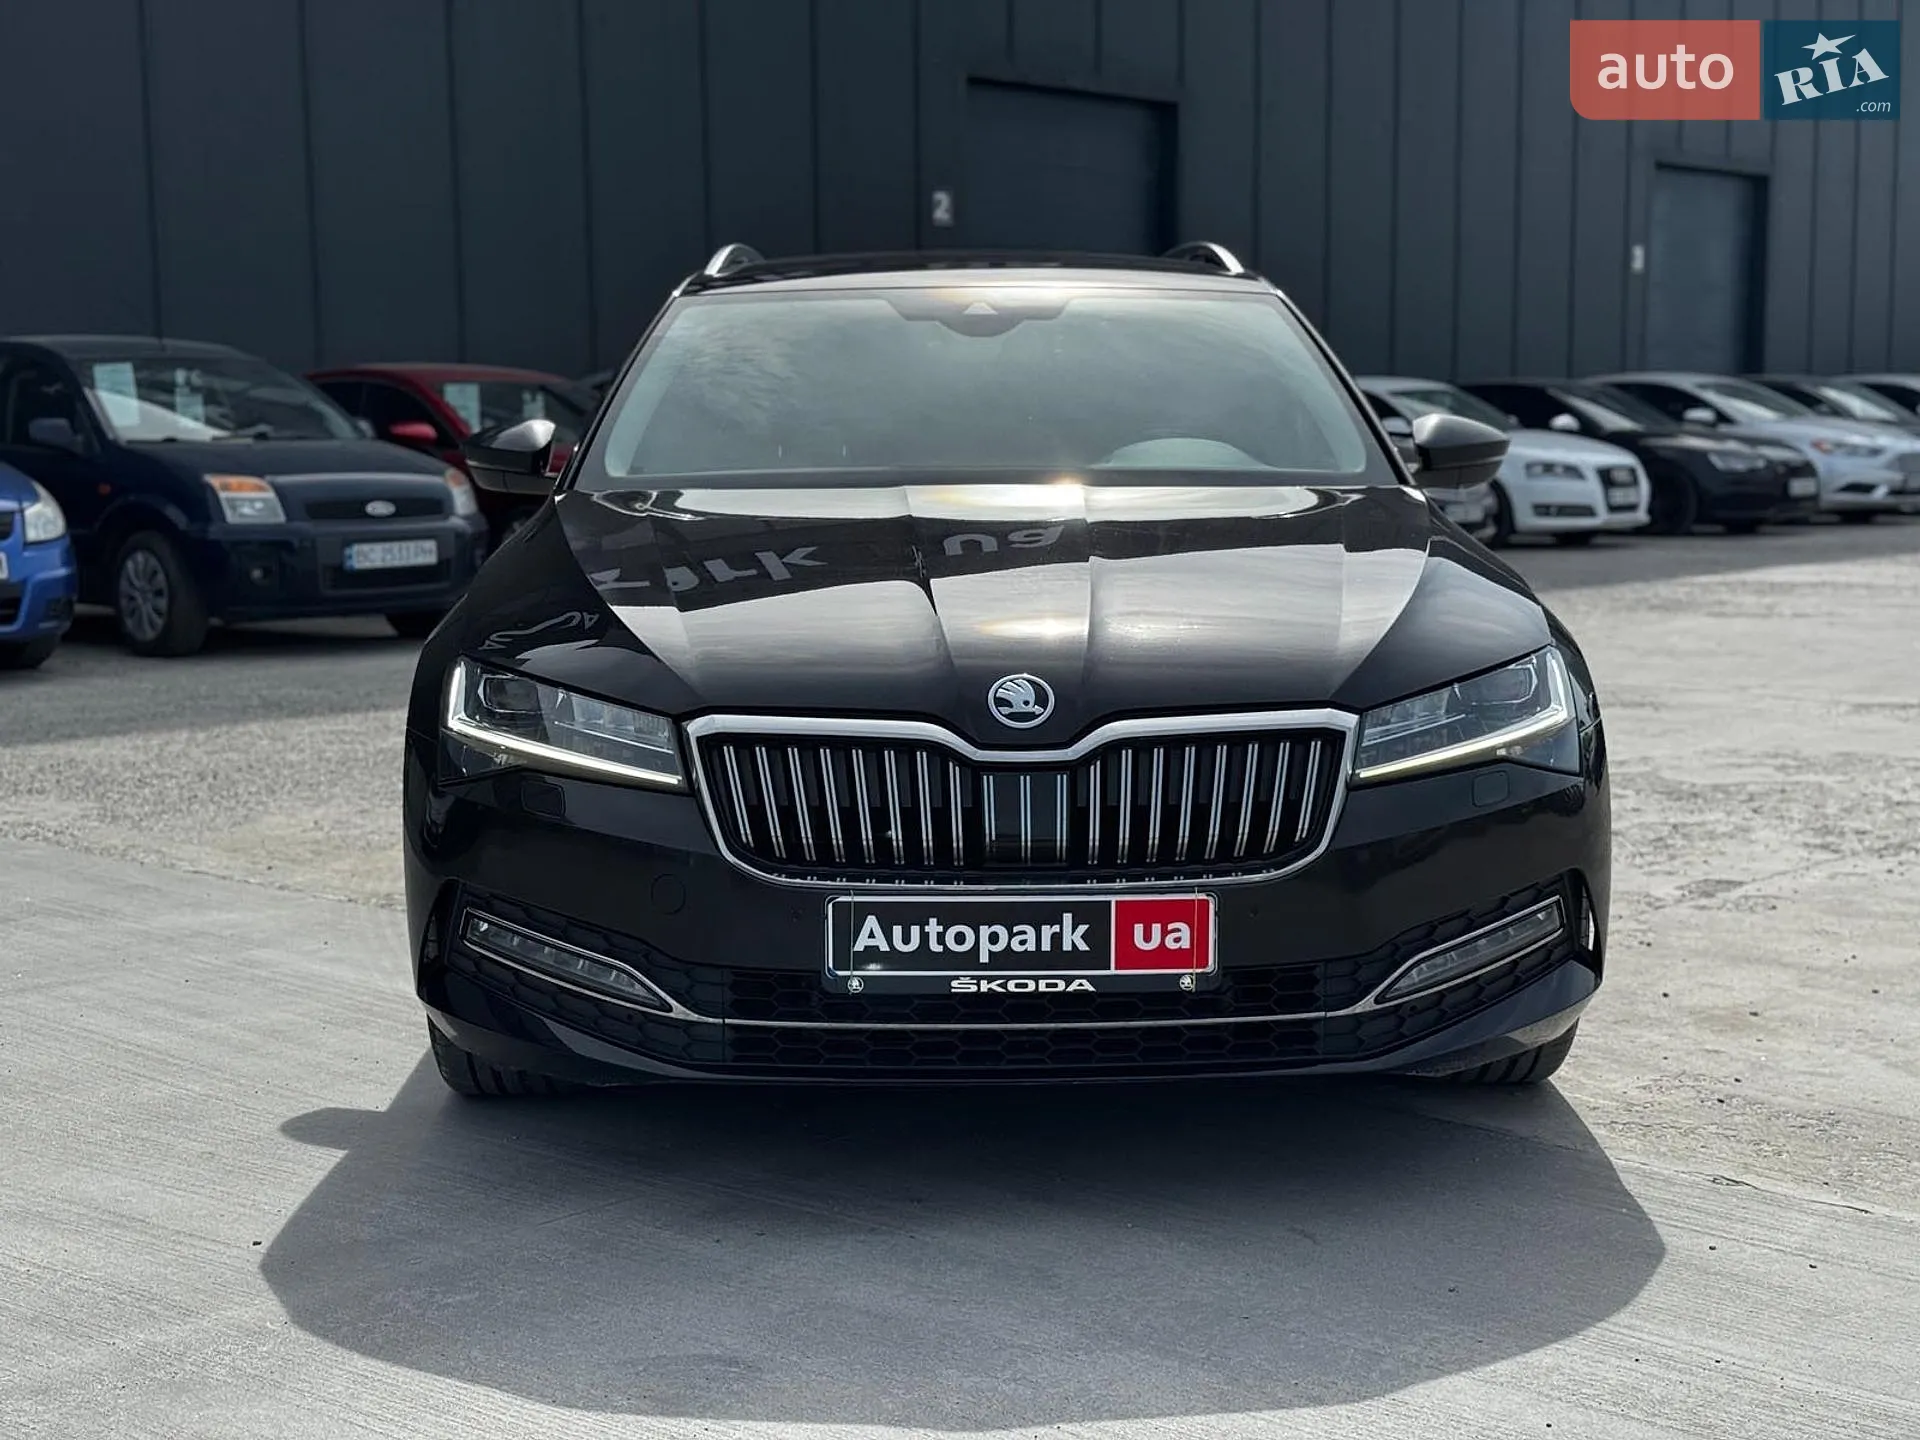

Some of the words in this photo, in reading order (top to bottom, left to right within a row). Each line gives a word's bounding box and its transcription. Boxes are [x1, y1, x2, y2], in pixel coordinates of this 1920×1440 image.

[932, 190, 951, 221] 2
[853, 913, 1091, 963] Autopark
[1133, 921, 1192, 950] ua
[950, 976, 1096, 993] ŠKODA
